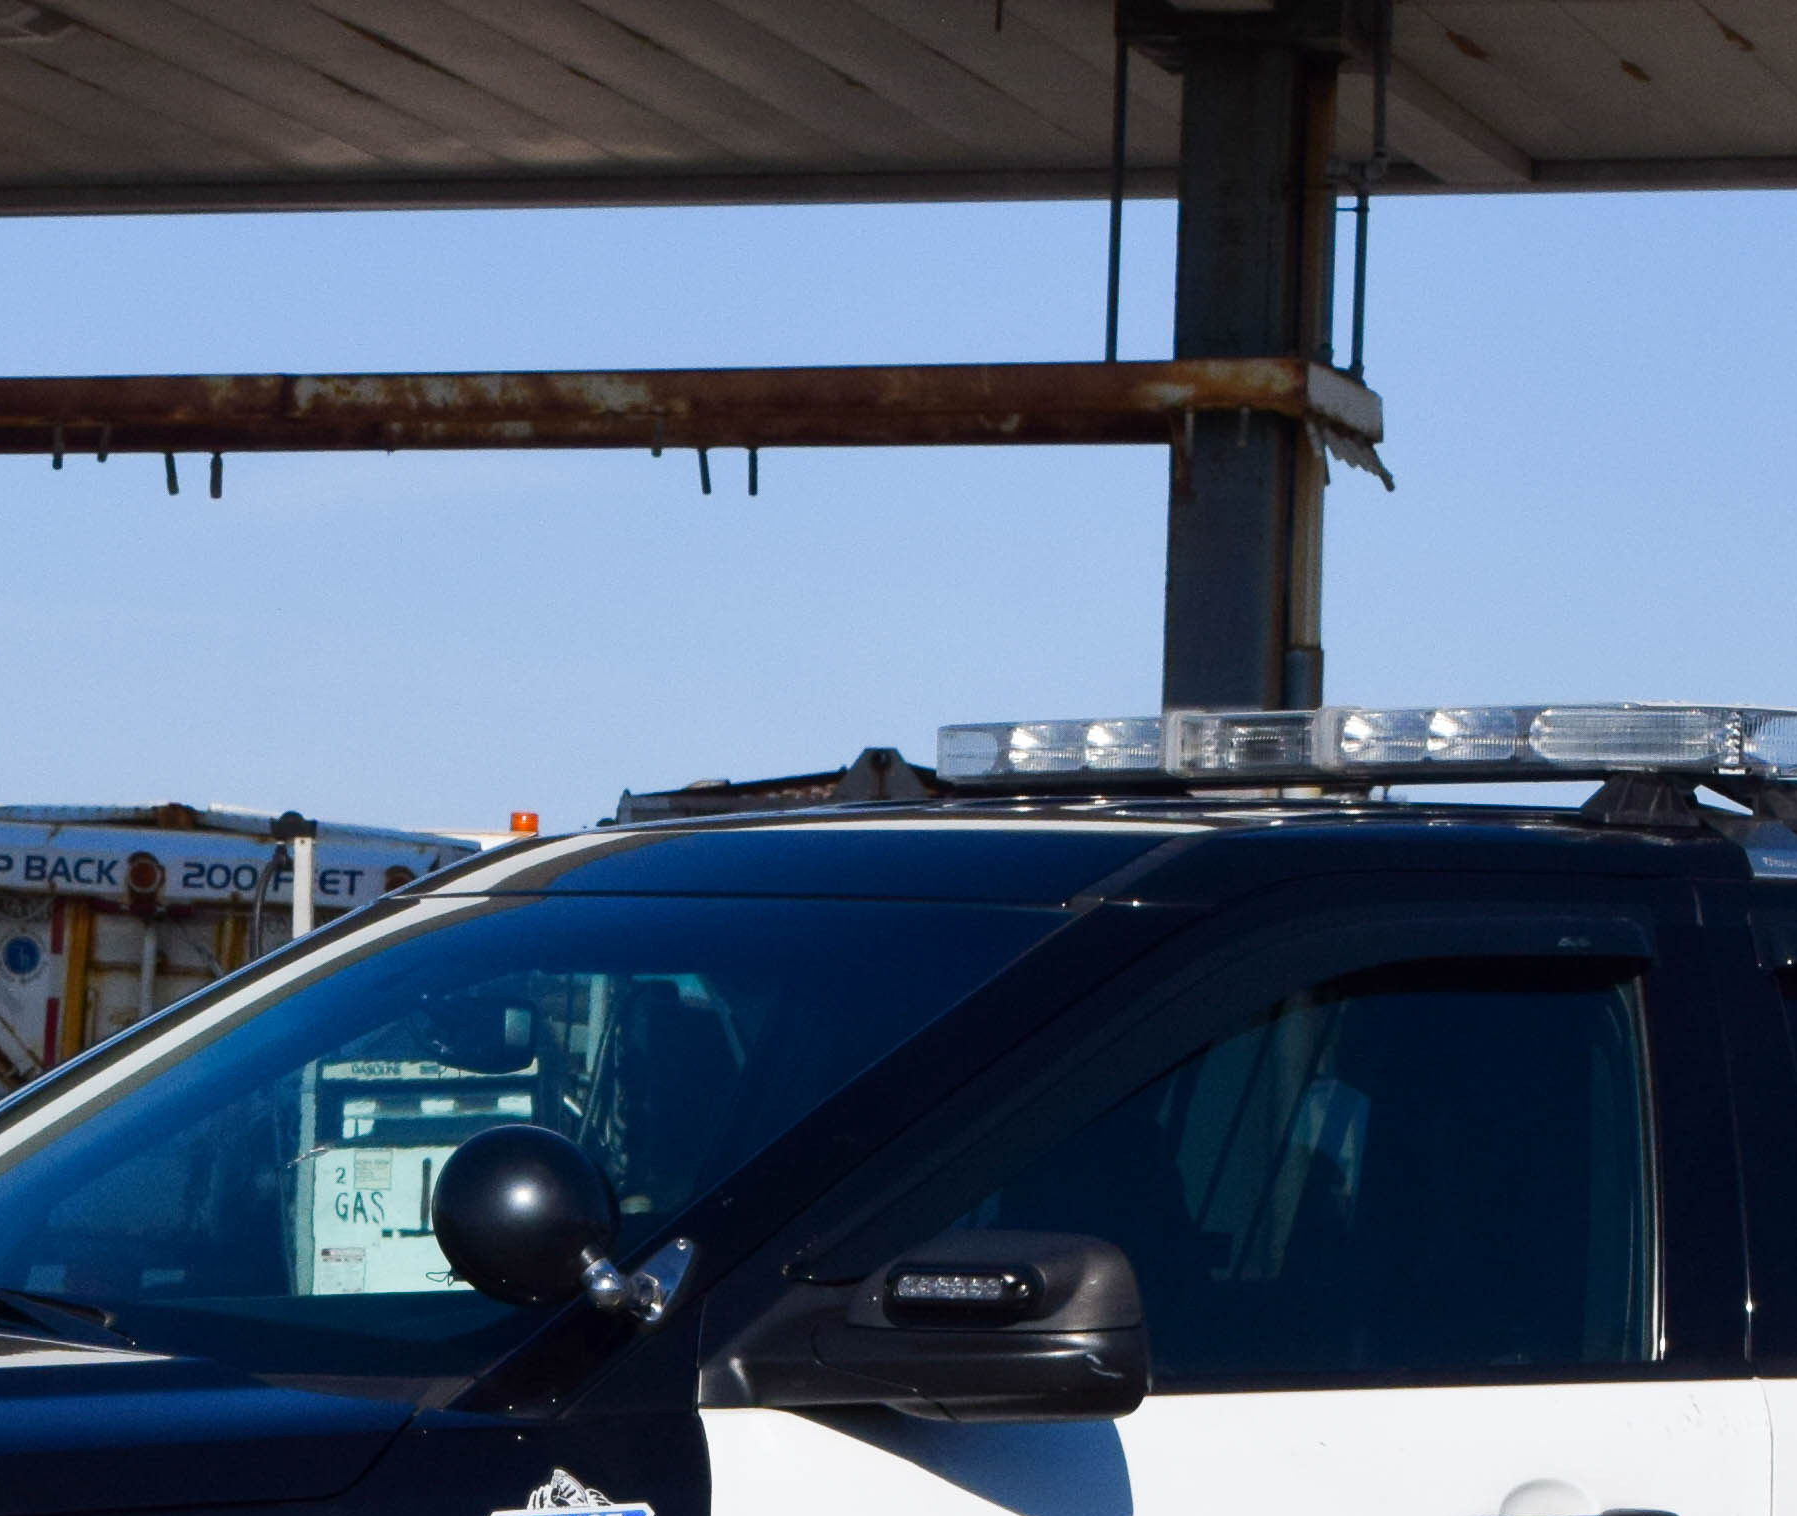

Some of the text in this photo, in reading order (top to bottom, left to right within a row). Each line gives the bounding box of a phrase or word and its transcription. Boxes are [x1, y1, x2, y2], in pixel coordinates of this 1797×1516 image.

[24, 854, 118, 886] BACK
[182, 861, 258, 891] 200
[272, 865, 364, 896] FET
[335, 1167, 347, 1185] 2
[335, 1190, 385, 1224] GAS
